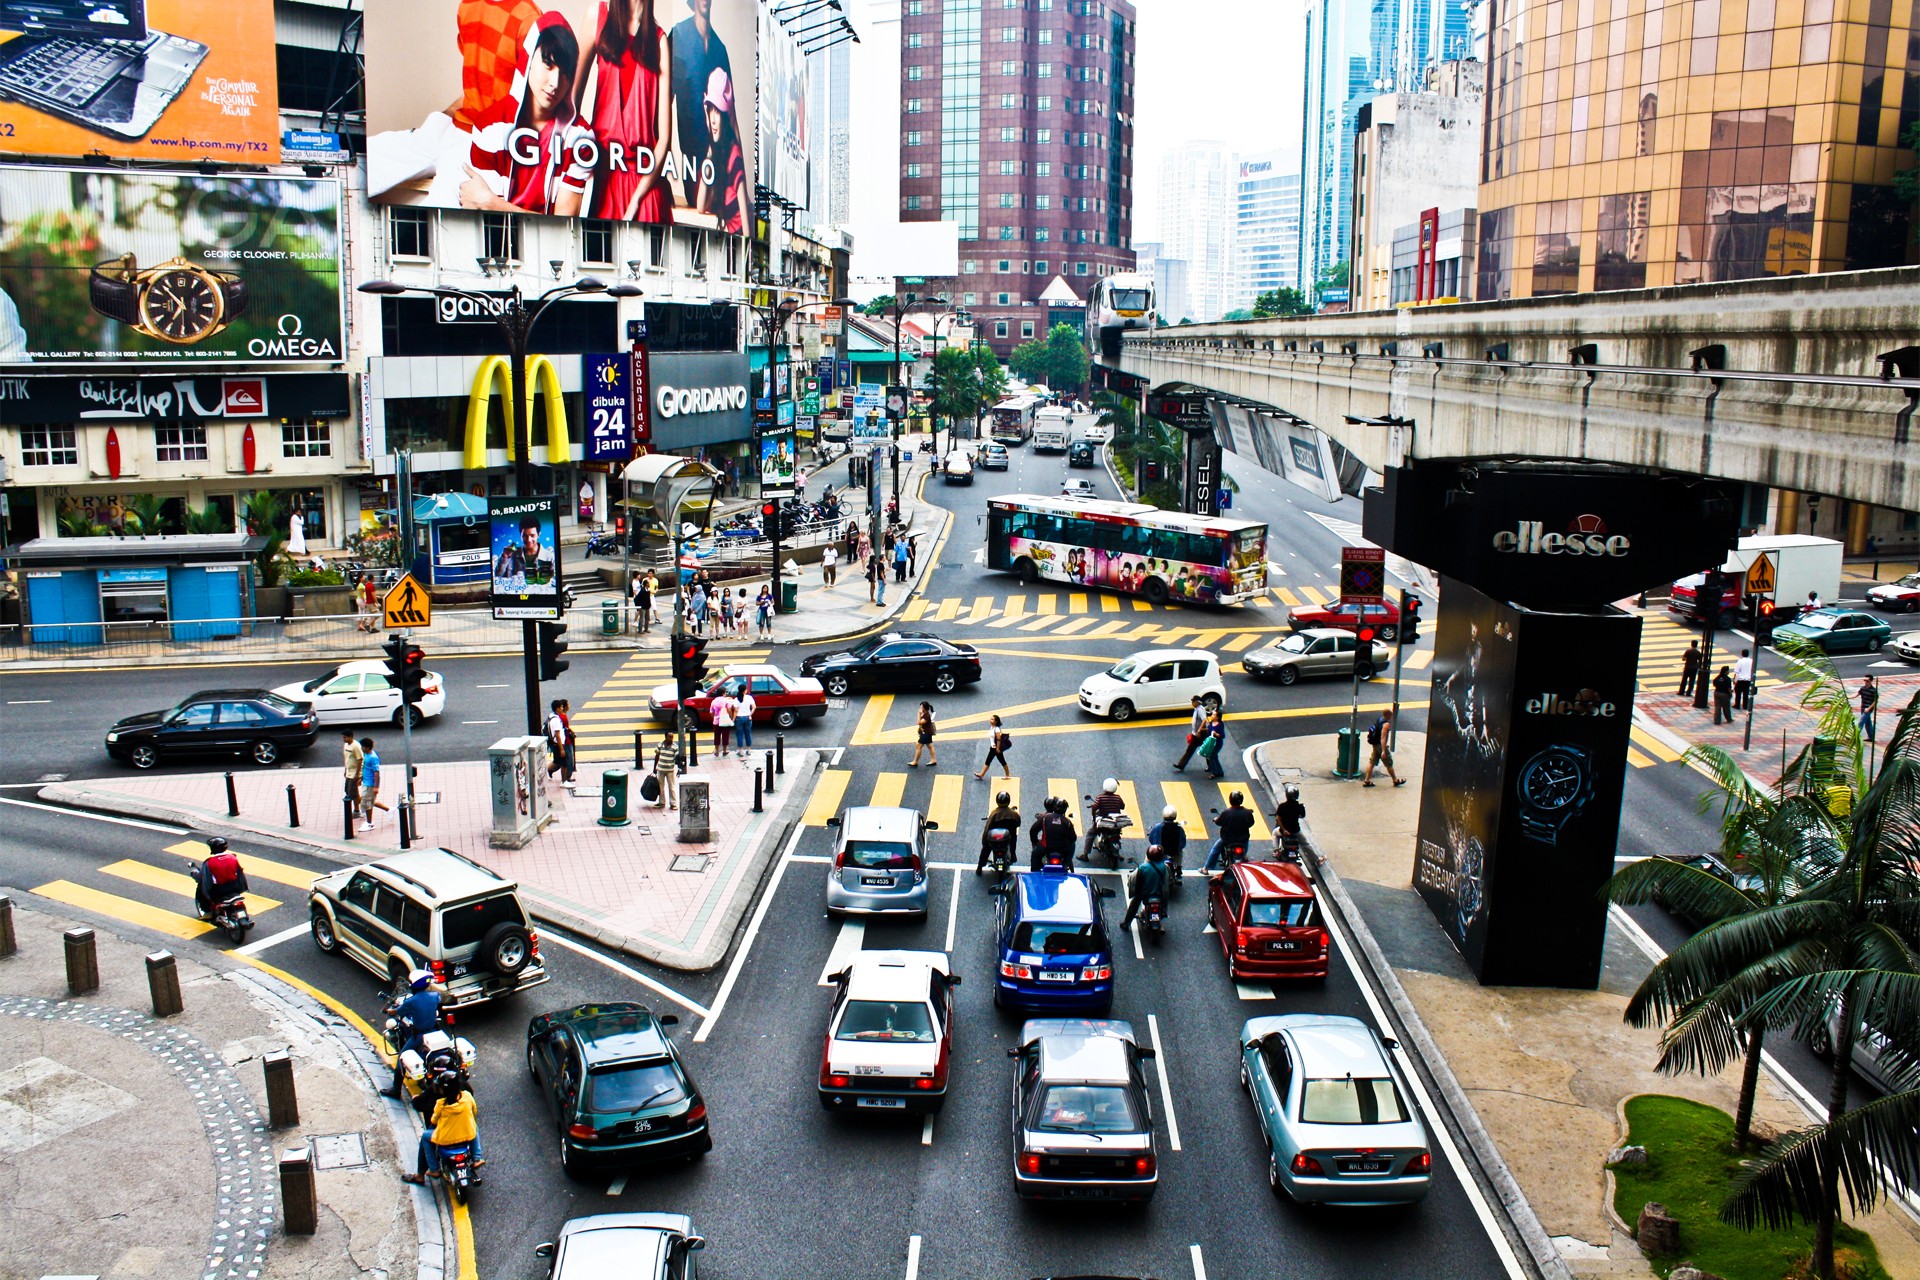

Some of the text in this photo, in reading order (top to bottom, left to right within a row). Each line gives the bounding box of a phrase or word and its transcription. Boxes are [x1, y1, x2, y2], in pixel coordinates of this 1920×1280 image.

[150, 138, 268, 152] www.hp.com.my/TX2
[507, 127, 716, 186] GIORDANO
[203, 250, 242, 259] GEORGE
[243, 250, 288, 260] CLOONEY.
[248, 338, 336, 356] OMEGA
[635, 350, 645, 433] McDonald's
[592, 396, 626, 407] dibuka
[657, 385, 747, 418] GIORDANO
[593, 408, 626, 437] 24
[594, 438, 626, 455] jam
[503, 501, 552, 514] BRAND'S!
[1492, 520, 1631, 557] ellesse
[461, 554, 481, 562] POLIS
[504, 584, 527, 592] Chilled
[1525, 692, 1616, 717] ellesse
